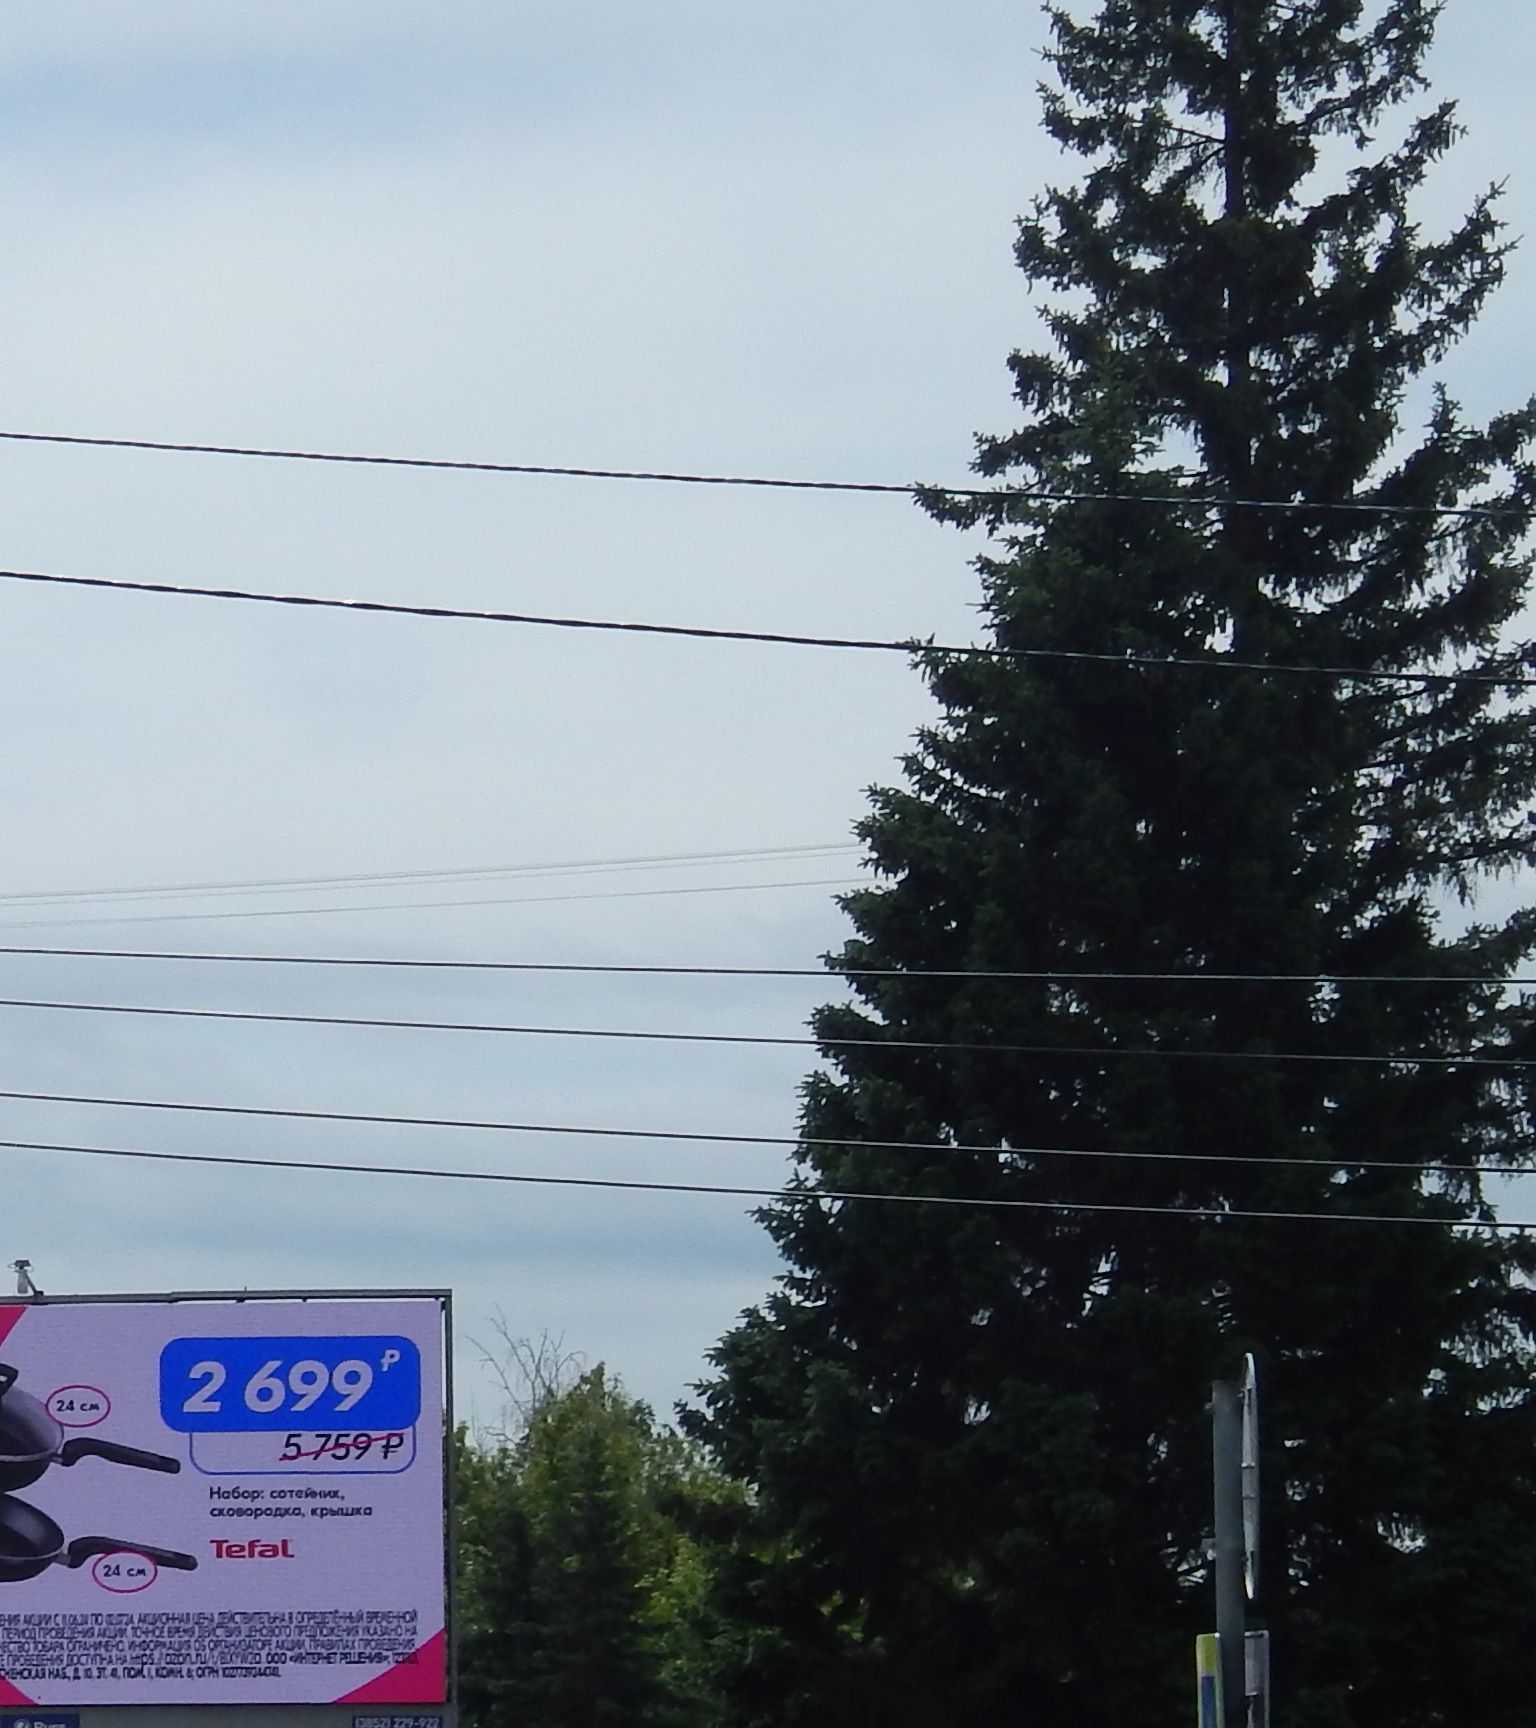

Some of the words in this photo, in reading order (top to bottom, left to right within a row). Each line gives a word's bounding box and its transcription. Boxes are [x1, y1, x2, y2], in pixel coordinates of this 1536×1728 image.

[243, 1359, 374, 1414] 699
[56, 1400, 75, 1412] 24
[79, 1402, 101, 1412] см
[209, 1486, 265, 1503] Набор:
[269, 1486, 345, 1501] сотейник,
[209, 1506, 306, 1520] сковородка,
[310, 1505, 373, 1520] крышка
[209, 1539, 295, 1559] Tefal
[102, 1564, 121, 1578] 24
[126, 1567, 147, 1577] см
